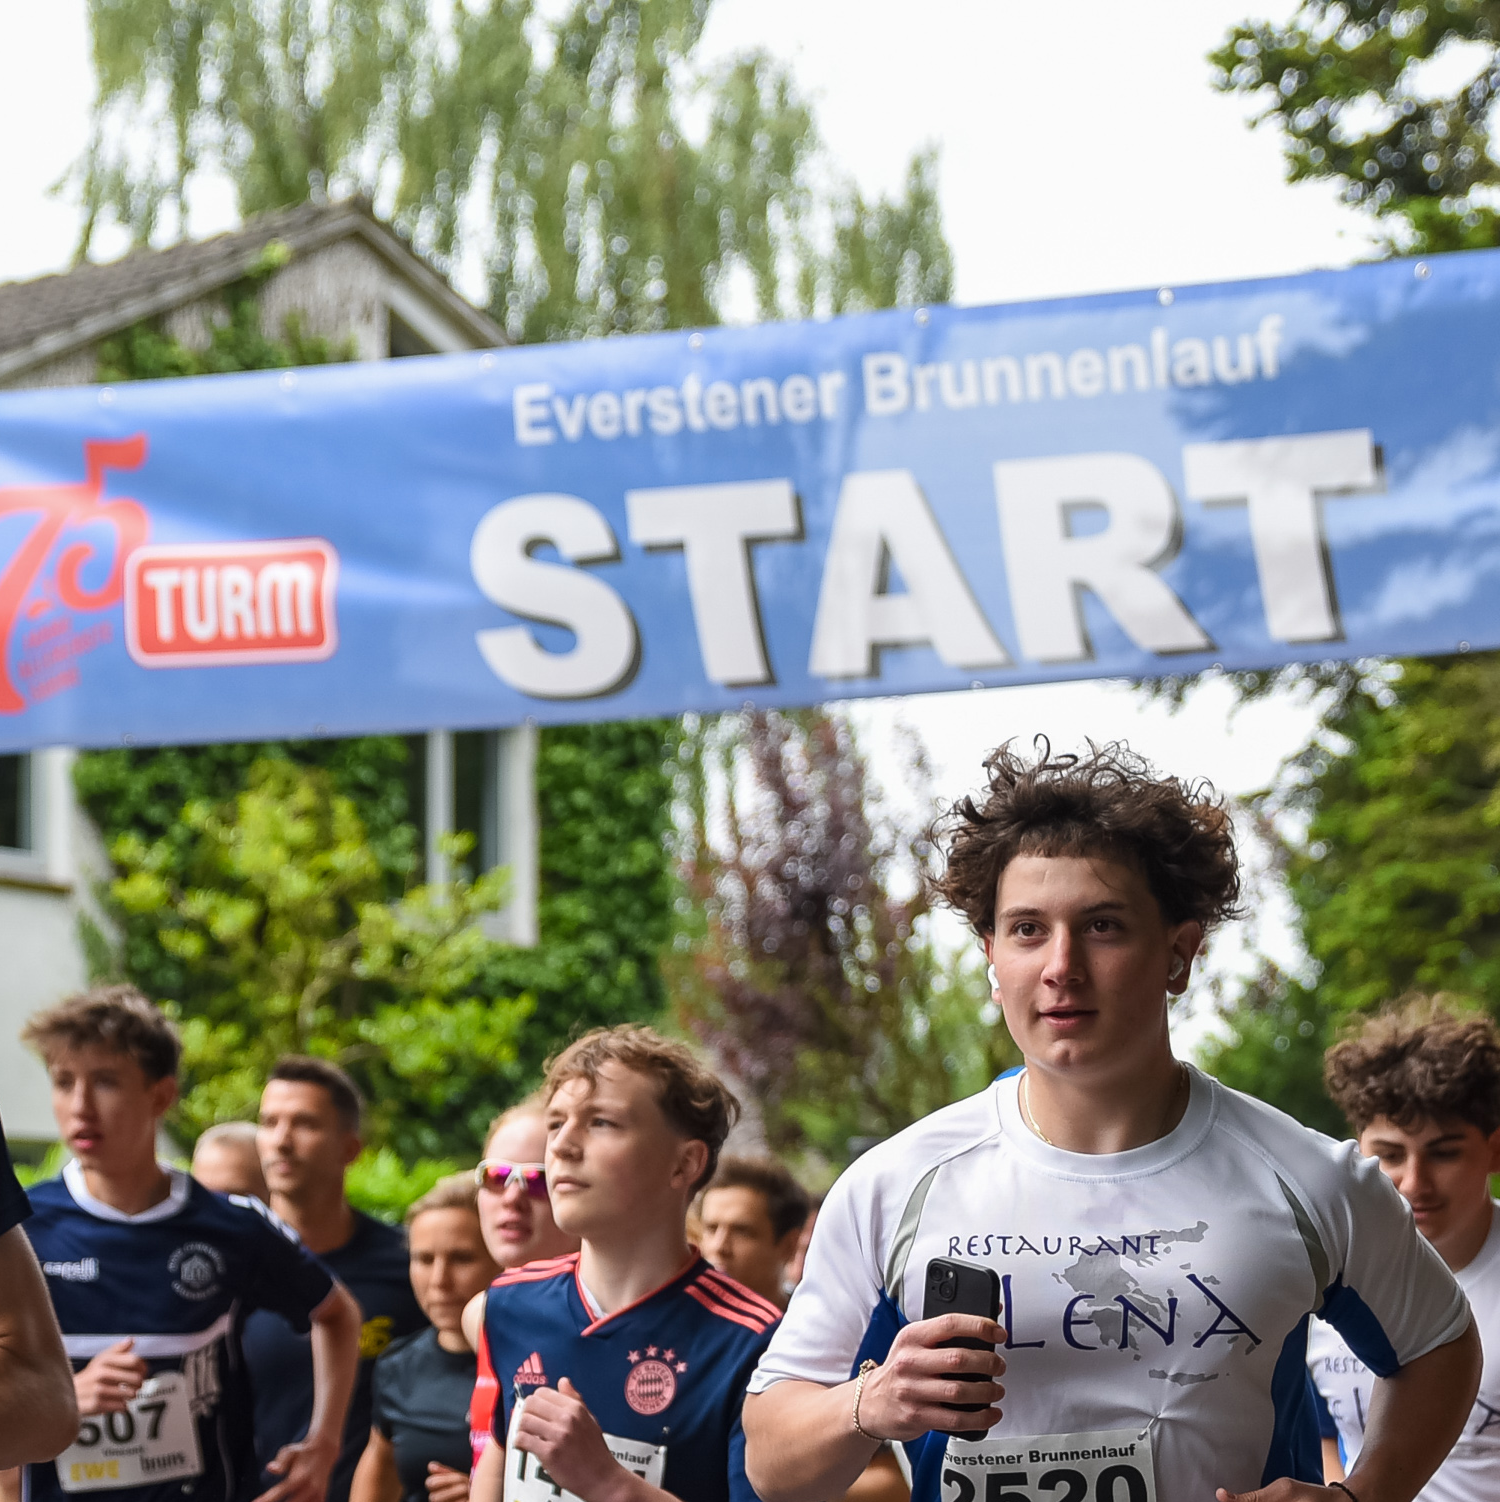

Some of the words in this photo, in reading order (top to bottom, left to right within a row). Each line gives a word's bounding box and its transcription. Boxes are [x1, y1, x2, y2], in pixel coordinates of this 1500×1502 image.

[511, 367, 845, 445] Everstener
[860, 315, 1287, 416] Brunnenlauf
[469, 428, 1384, 701] START
[143, 562, 316, 643] TURM
[947, 1234, 1162, 1257] RESTAURANT
[1001, 1274, 1262, 1351] LENA
[1325, 1357, 1367, 1373] REST
[513, 1373, 547, 1385] adidas
[610, 1450, 652, 1465] enlauf
[1029, 1444, 1136, 1463] Brunnenlauf
